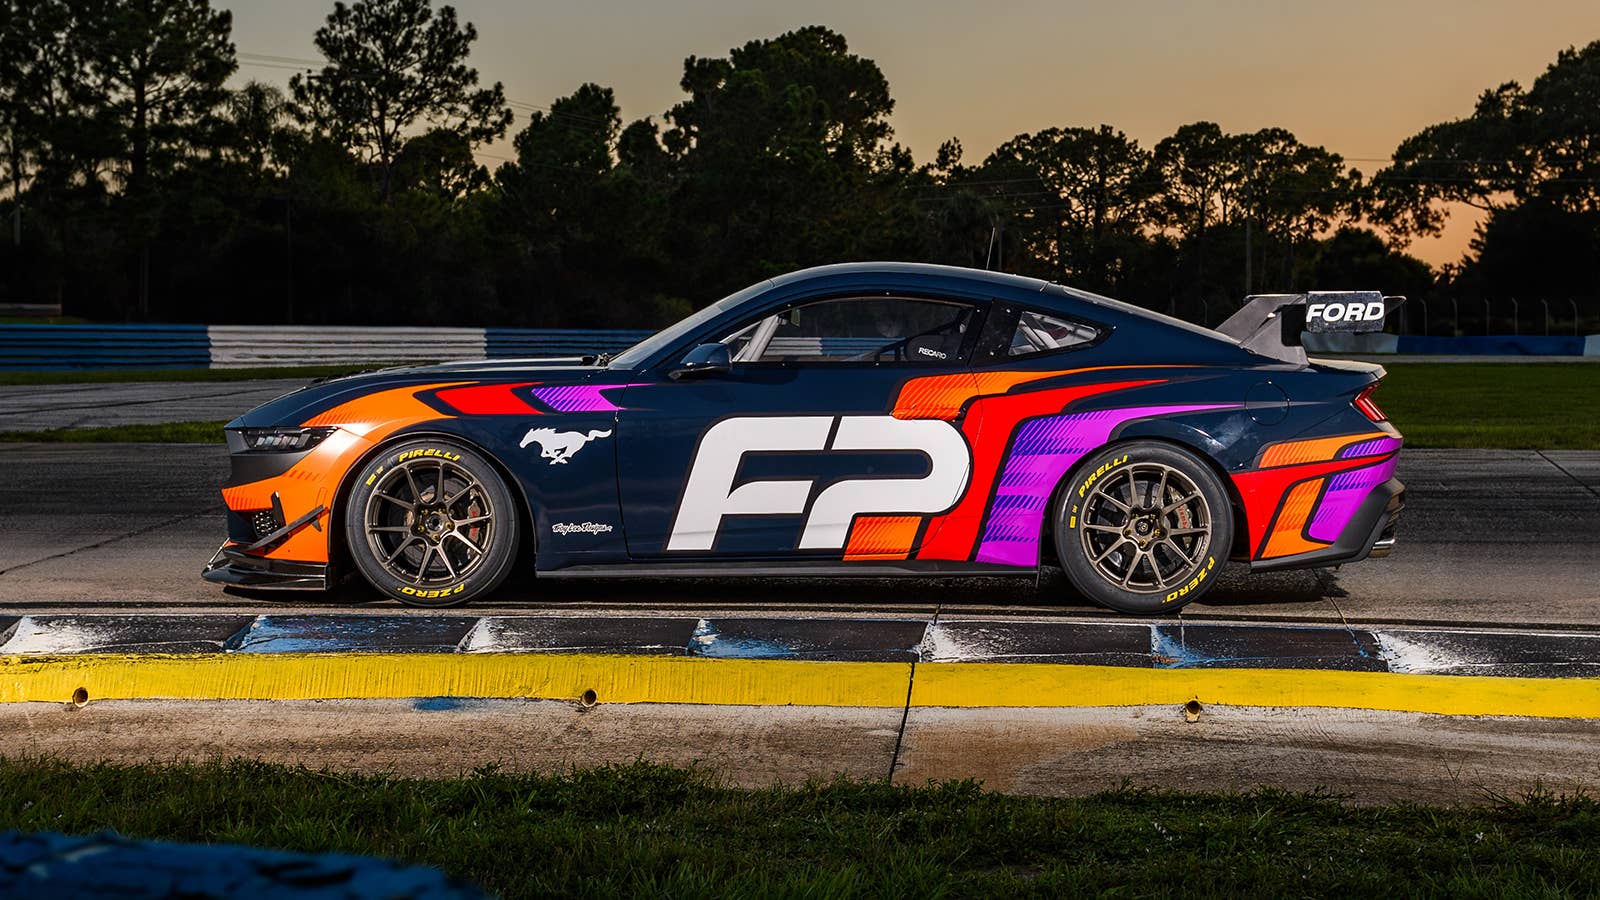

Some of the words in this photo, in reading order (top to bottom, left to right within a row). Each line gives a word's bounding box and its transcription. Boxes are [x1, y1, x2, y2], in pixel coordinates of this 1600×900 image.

[1305, 302, 1385, 323] FORD
[918, 346, 947, 360] RECARO
[398, 448, 461, 462] PIRELLI
[656, 415, 970, 551] FP
[1078, 455, 1129, 498] PIRELLI
